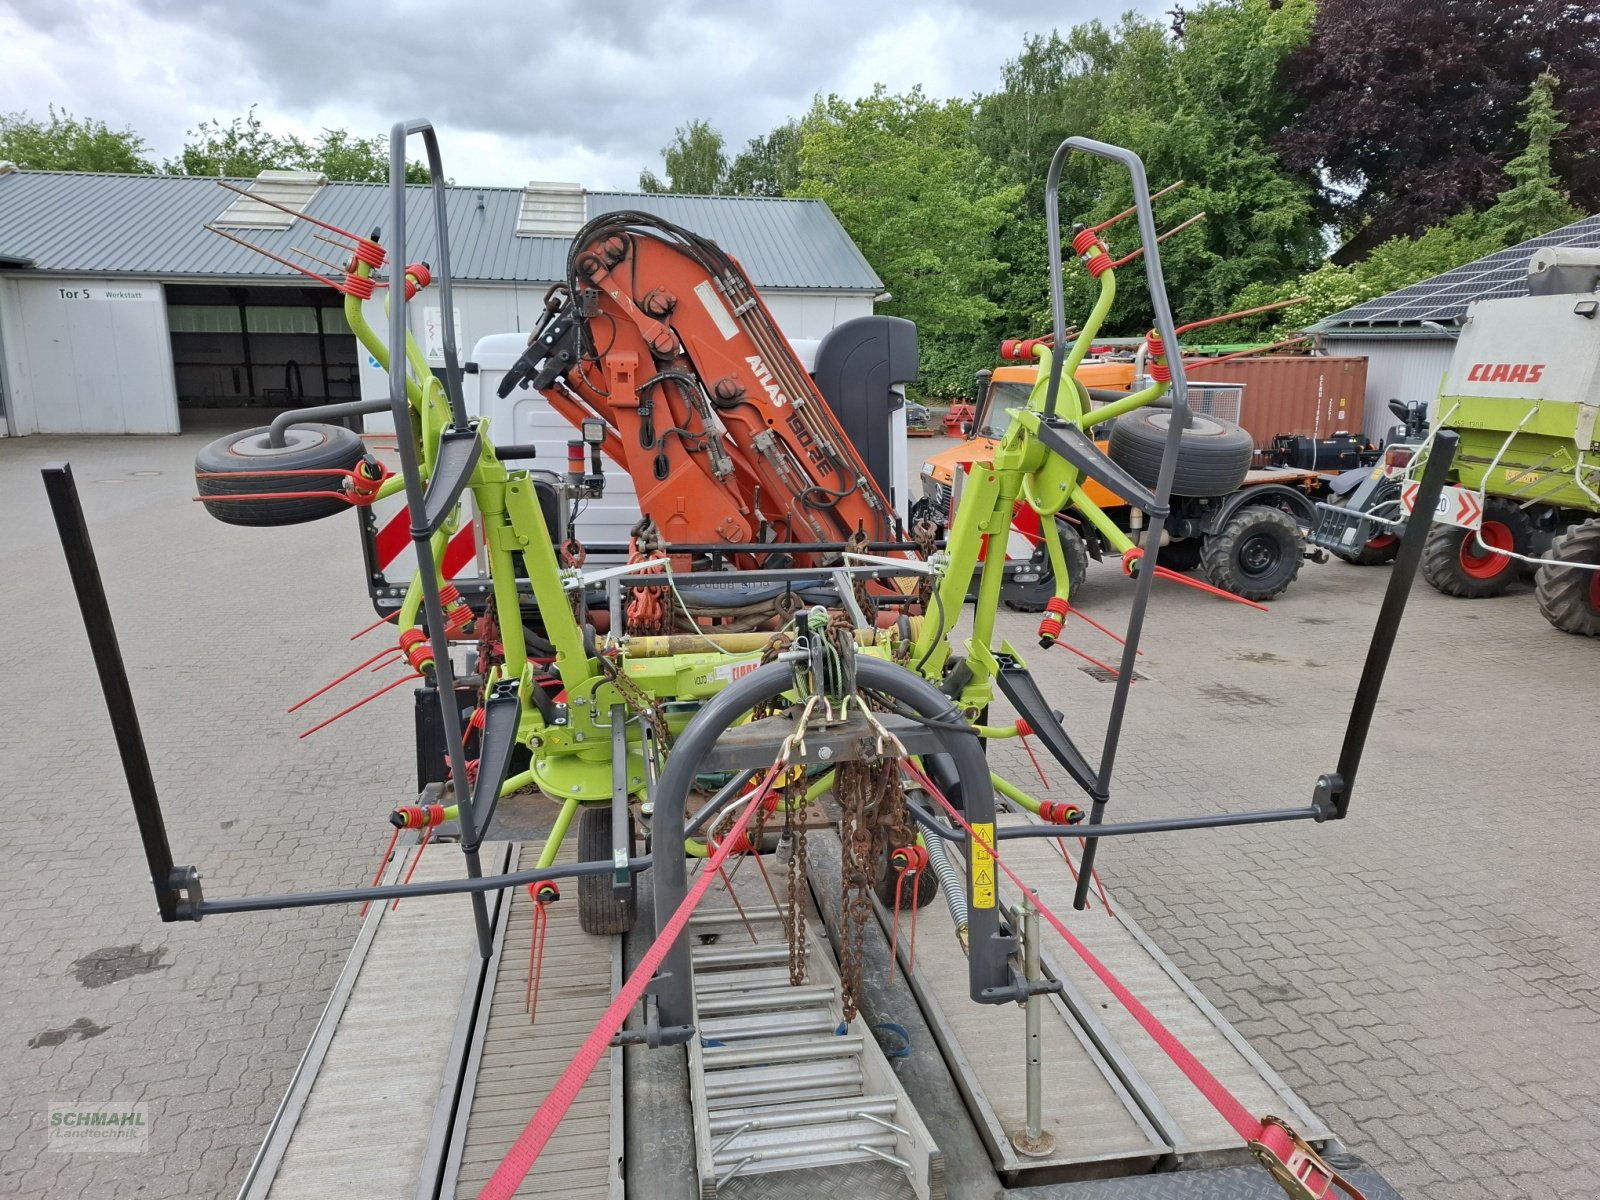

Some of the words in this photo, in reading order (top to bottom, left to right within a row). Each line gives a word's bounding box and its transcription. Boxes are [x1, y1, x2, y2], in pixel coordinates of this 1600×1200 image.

[59, 288, 79, 299] Tor
[83, 288, 90, 299] 5
[105, 291, 142, 299] Werkstatt
[744, 355, 788, 408] ATLAS
[1467, 363, 1547, 383] CLAAS
